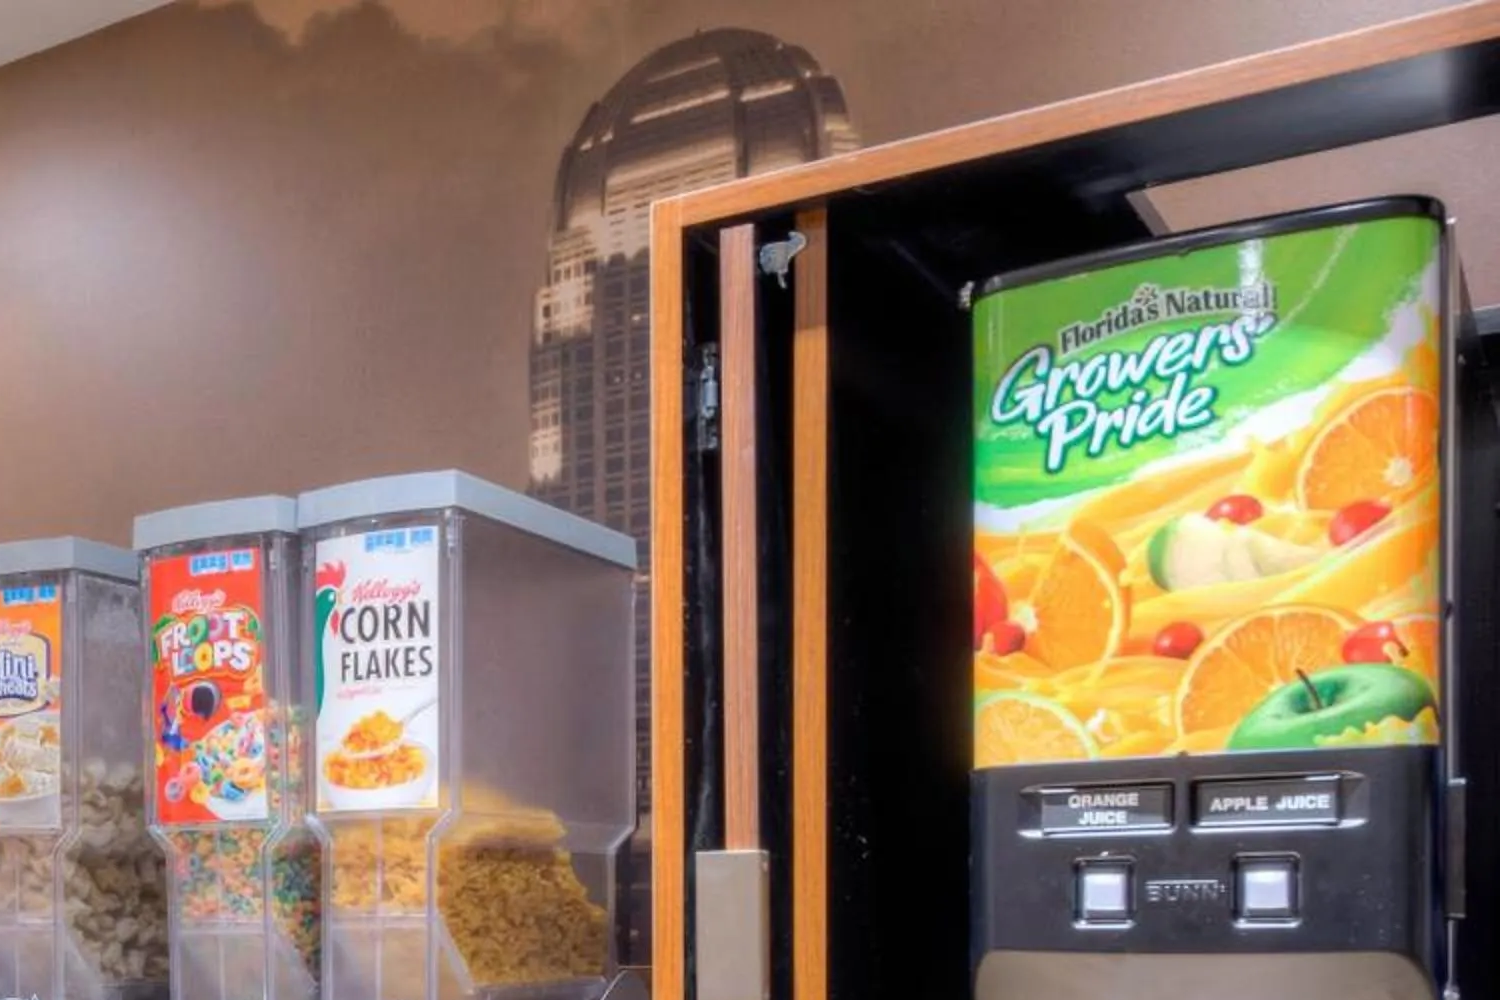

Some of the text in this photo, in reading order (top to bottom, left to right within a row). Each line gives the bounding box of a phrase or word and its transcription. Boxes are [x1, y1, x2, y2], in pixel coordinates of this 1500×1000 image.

[1037, 374, 1218, 473] Pride
[352, 578, 421, 604] Kellogg's
[160, 611, 245, 660] FROOT
[340, 600, 431, 645] CORN
[171, 640, 252, 677] LOOPS
[340, 645, 433, 684] FLAKES
[1067, 792, 1140, 809] ORANGE
[1078, 810, 1128, 826] JUICE
[1209, 794, 1331, 813] APPLE JUICE
